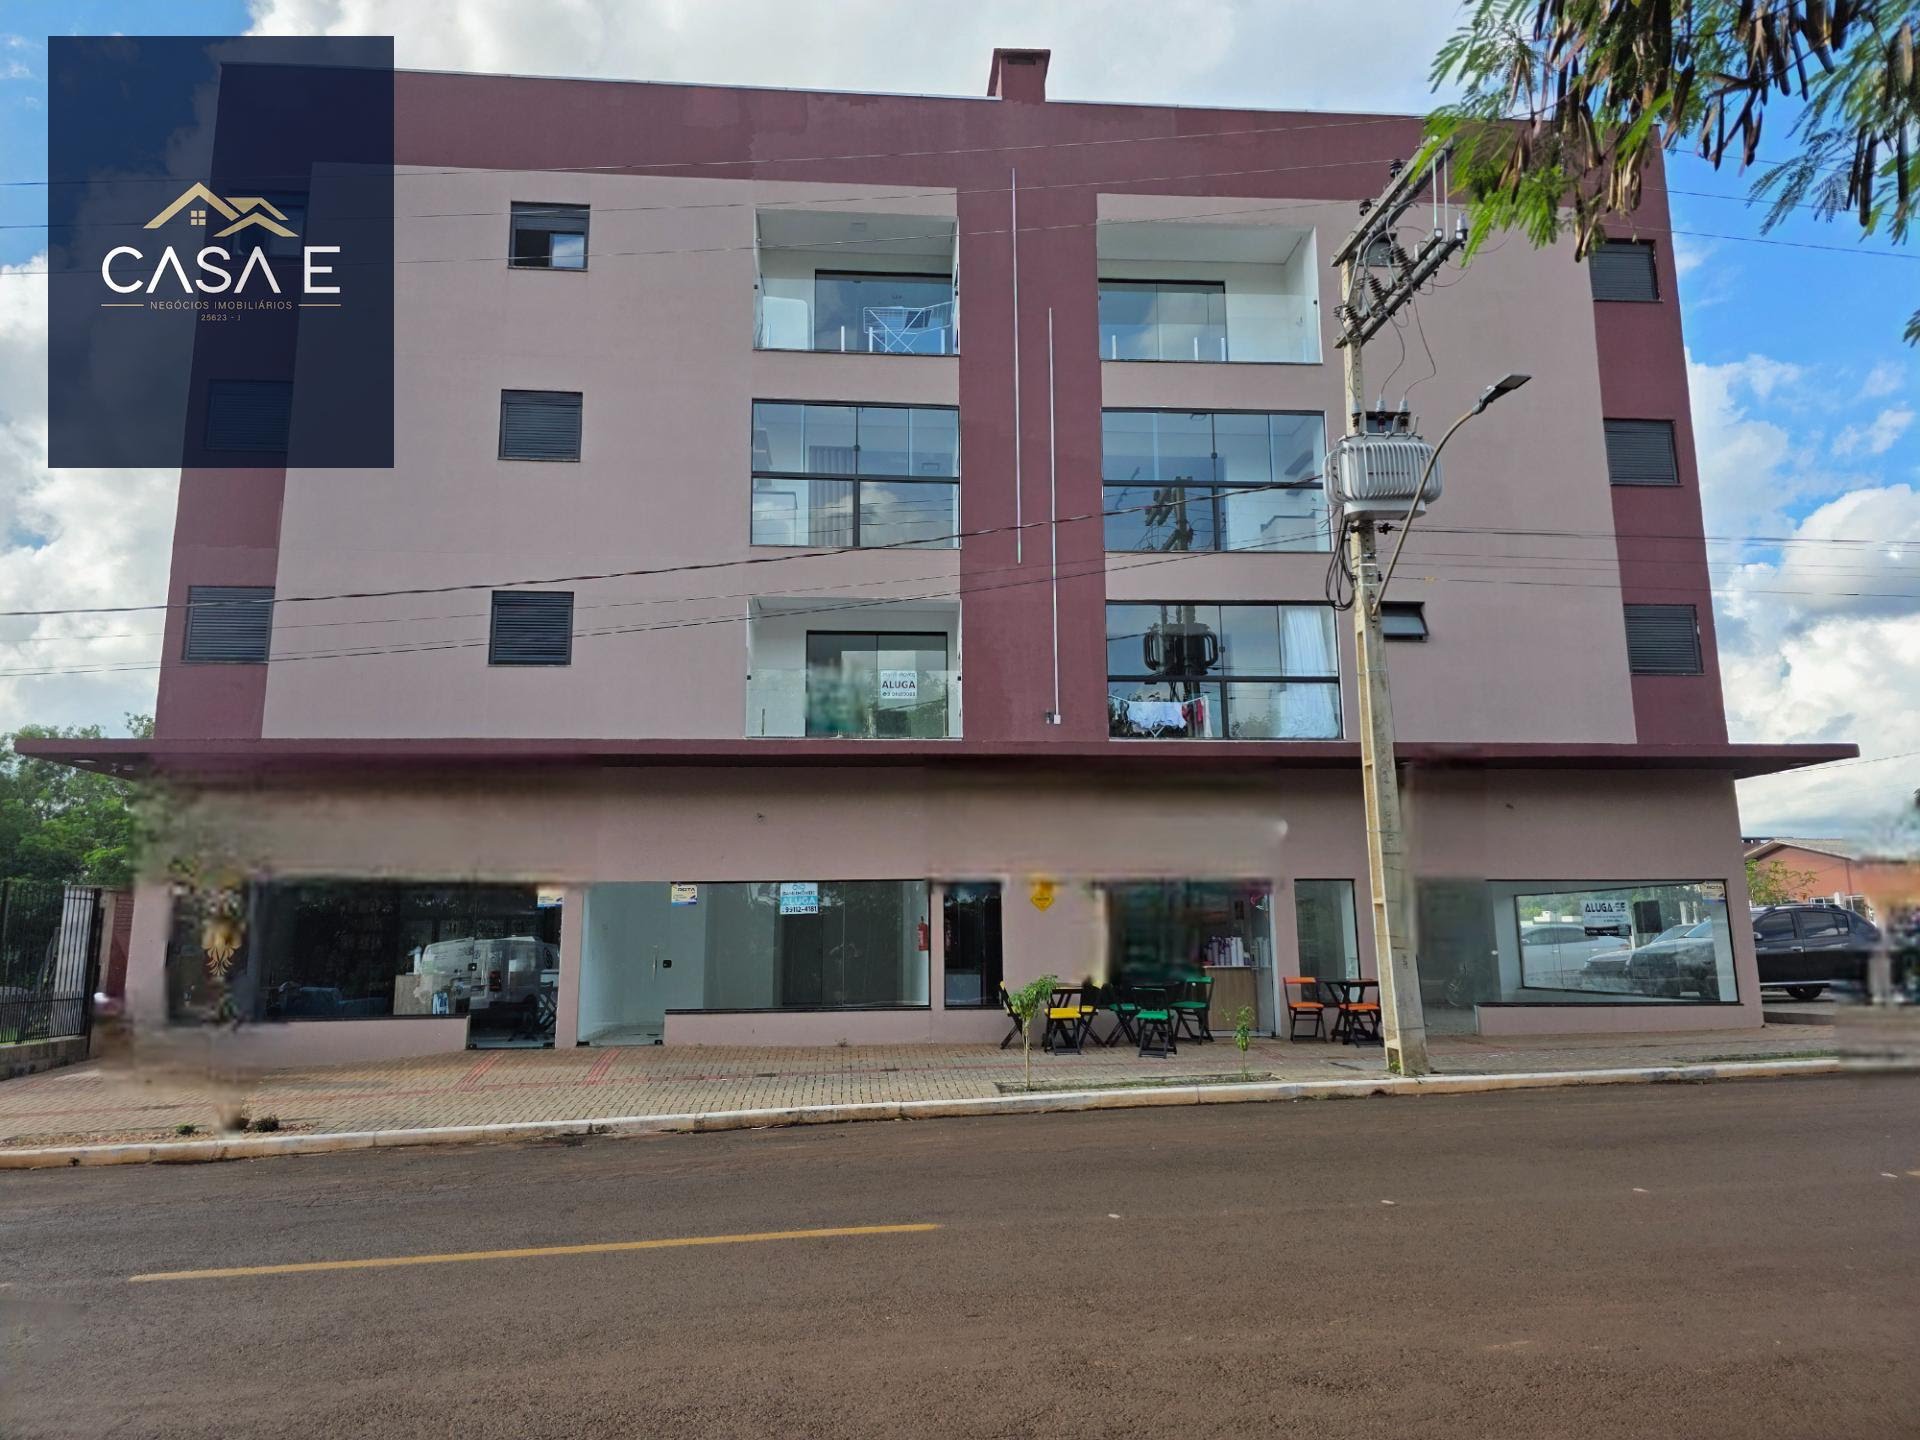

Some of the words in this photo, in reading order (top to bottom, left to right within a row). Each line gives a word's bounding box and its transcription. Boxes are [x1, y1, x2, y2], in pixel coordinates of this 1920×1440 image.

[881, 680, 916, 689] ALUGA
[782, 895, 817, 905] ALUGA
[1584, 901, 1626, 913] ALUGA-SE
